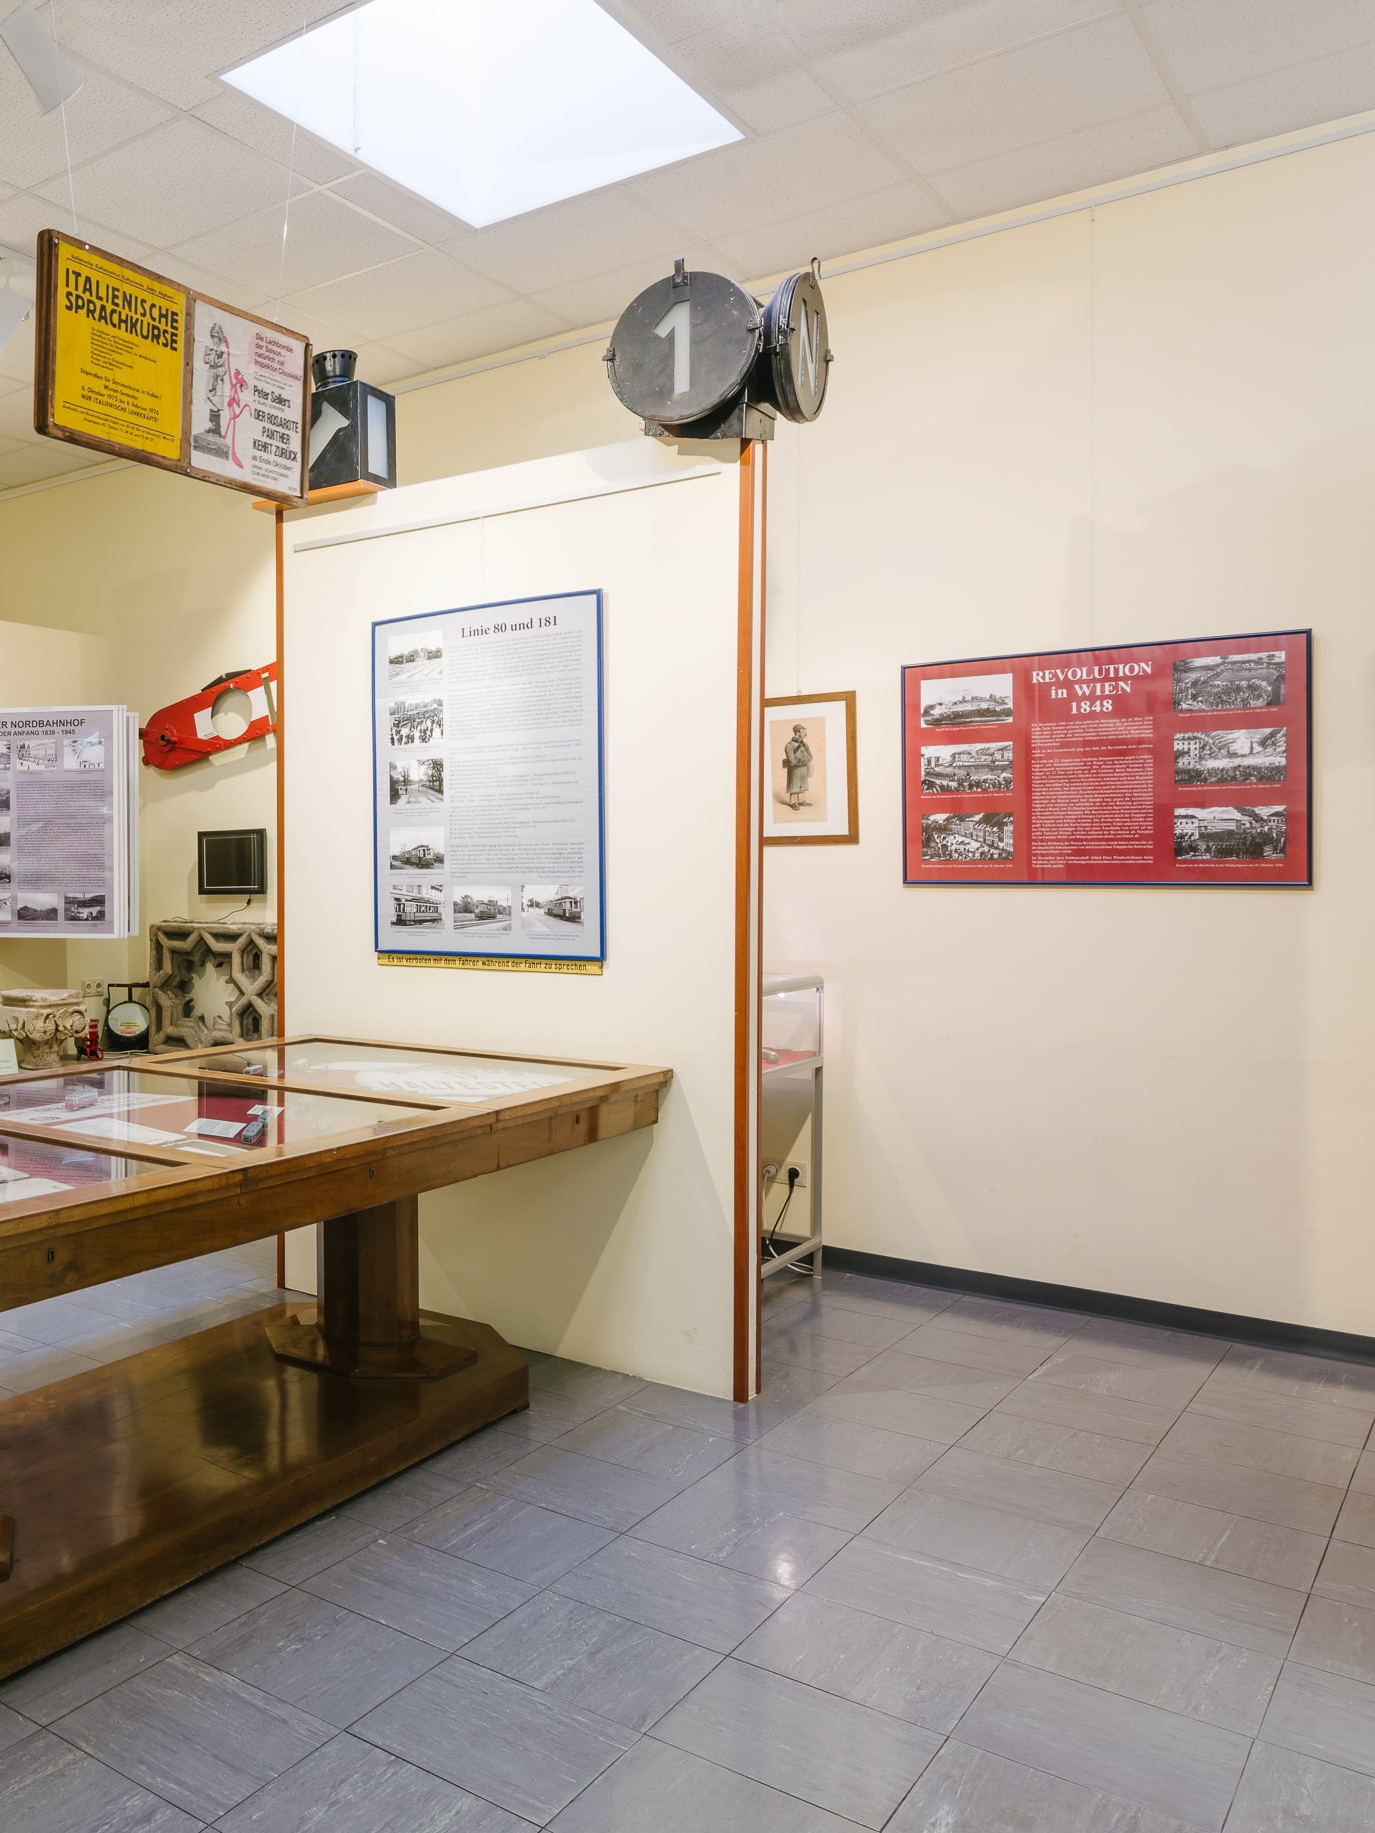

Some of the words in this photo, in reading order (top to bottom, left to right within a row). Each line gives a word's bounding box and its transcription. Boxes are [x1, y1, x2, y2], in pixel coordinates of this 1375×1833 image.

[66, 267, 178, 331] ITALIENISCHE
[65, 291, 178, 352] SPRACHKURSE
[255, 332, 264, 342] Die
[652, 300, 690, 394] 1
[93, 396, 127, 413] ITALIENISCHE
[253, 385, 270, 401] Peter
[270, 391, 291, 409] Sellers
[254, 408, 266, 422] DER
[266, 412, 299, 434] ROSAROTE
[262, 426, 291, 446] PANTHER
[253, 438, 273, 455] KEHRT
[273, 444, 298, 463] ZURÜCK
[461, 623, 490, 638] Linie
[493, 621, 508, 635] 80
[510, 617, 534, 632] und
[538, 615, 558, 629] 181
[1031, 662, 1153, 684] REVOLUTION
[1051, 685, 1067, 699] in
[1074, 680, 1132, 697] WIEN
[1070, 699, 1113, 715] 1848
[10, 718, 86, 730] NORDBAHNHOF
[13, 729, 40, 737] ANFANG
[41, 729, 56, 737] 1838
[387, 955, 396, 963] Es
[405, 956, 432, 965] verboten
[433, 957, 443, 965] mit
[444, 957, 457, 965] dem
[458, 957, 480, 966] Fahrer
[481, 959, 510, 968] während
[511, 960, 523, 968] der
[525, 960, 542, 969] Fahrt
[544, 962, 553, 970] zu
